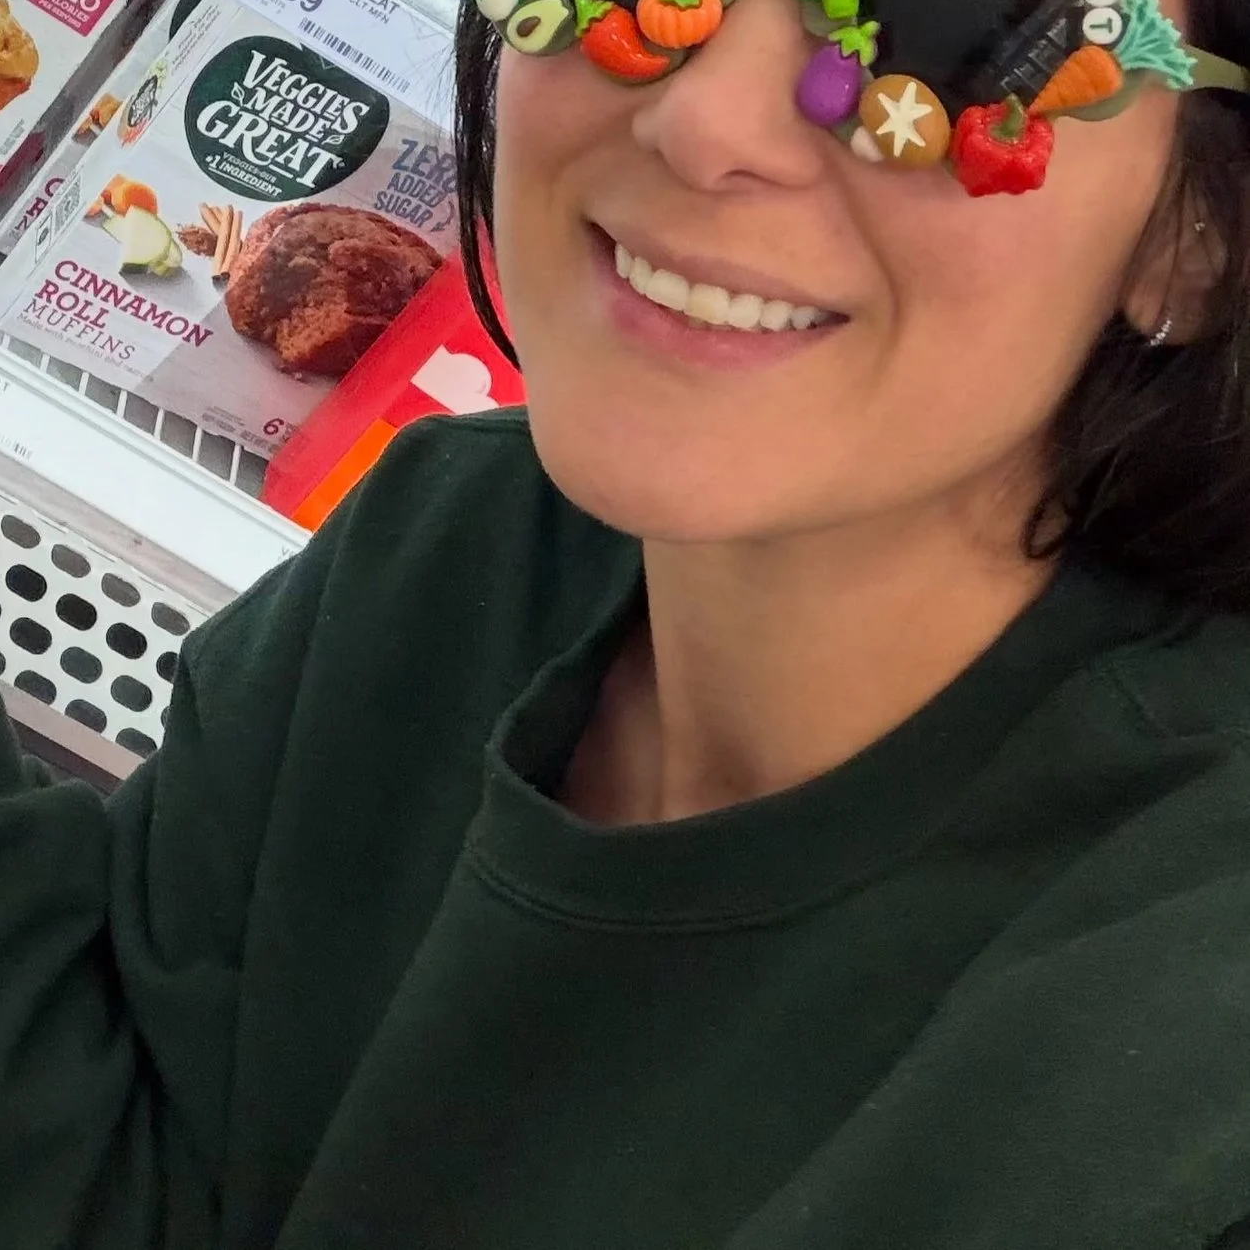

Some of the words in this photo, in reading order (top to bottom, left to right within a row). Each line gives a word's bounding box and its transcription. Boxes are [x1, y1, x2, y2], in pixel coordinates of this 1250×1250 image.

[367, 6, 390, 24] MFN
[243, 87, 330, 143] MADE
[248, 49, 370, 135] VEGGIES
[194, 99, 341, 190] GREAT
[219, 161, 282, 197] INGREDIENT
[388, 172, 448, 208] ADDED
[375, 191, 433, 228] SUGAR
[23, 297, 135, 361] MUFFINS
[34, 278, 110, 329] ROLL
[53, 259, 214, 348] CINNAMON
